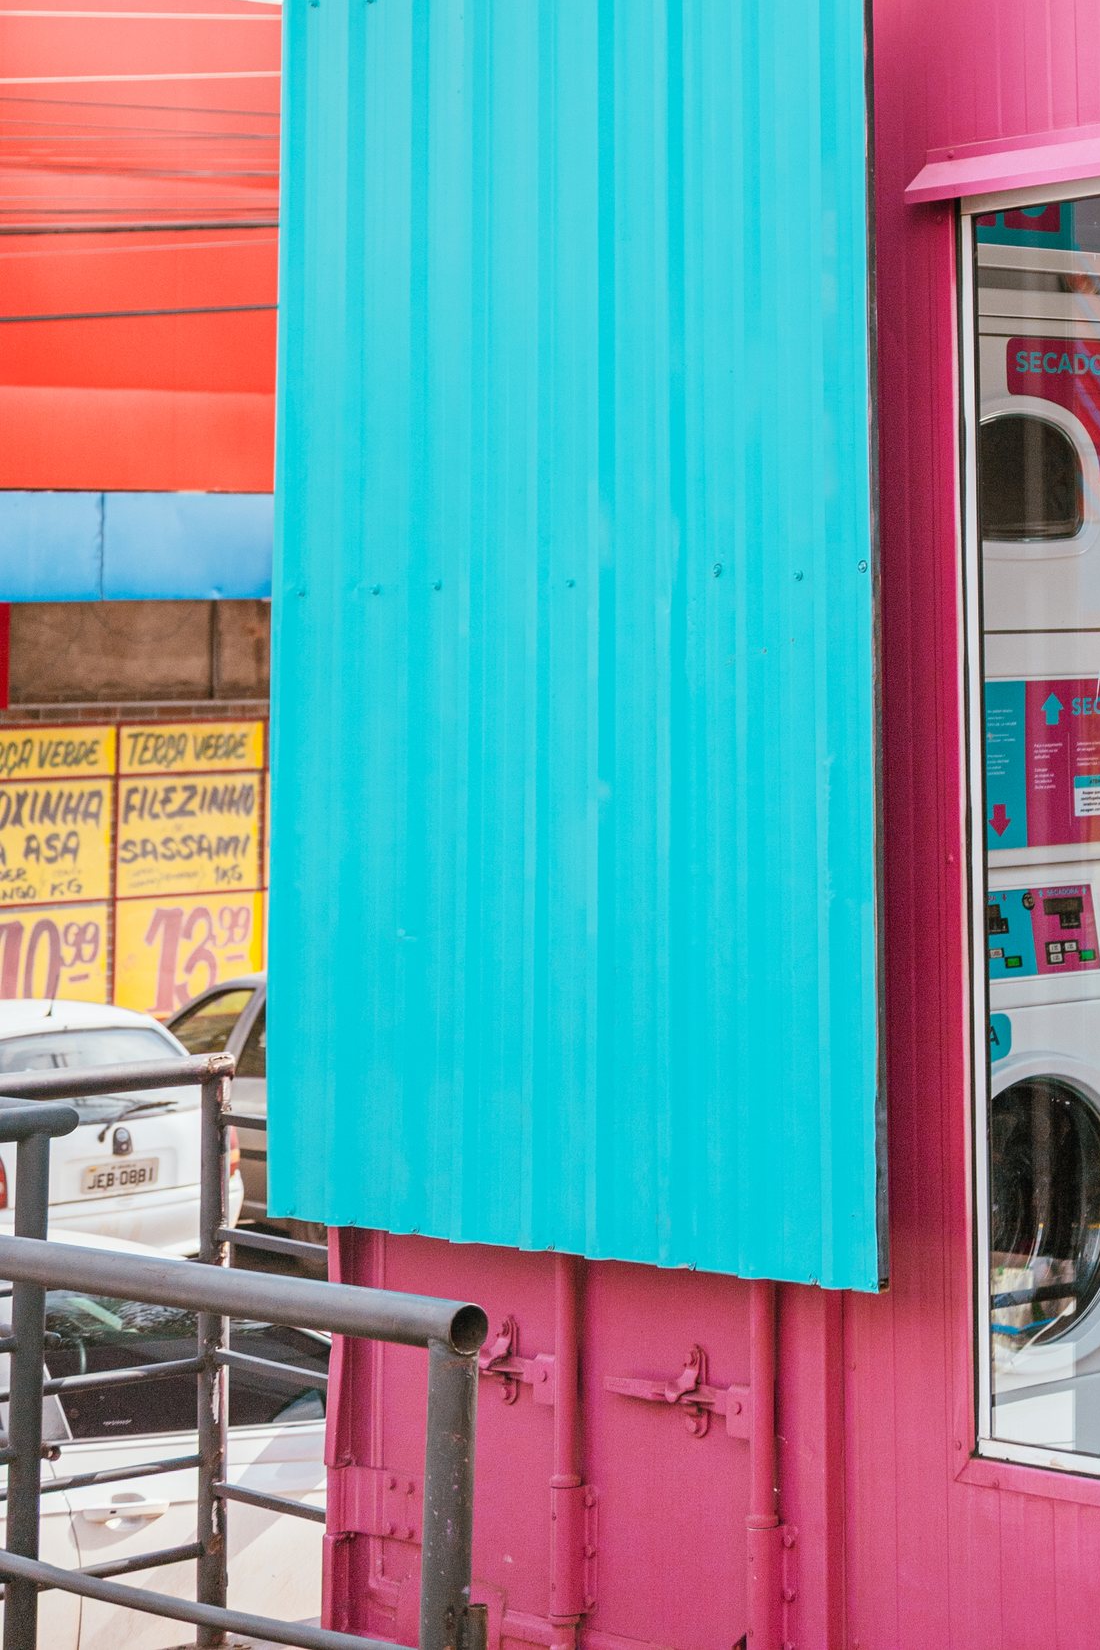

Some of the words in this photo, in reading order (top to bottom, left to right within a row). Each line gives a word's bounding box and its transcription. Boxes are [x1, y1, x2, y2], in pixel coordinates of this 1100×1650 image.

[123, 784, 255, 825] FILEZINHO
[23, 830, 80, 865] ASA
[120, 834, 250, 864] SASSAMI
